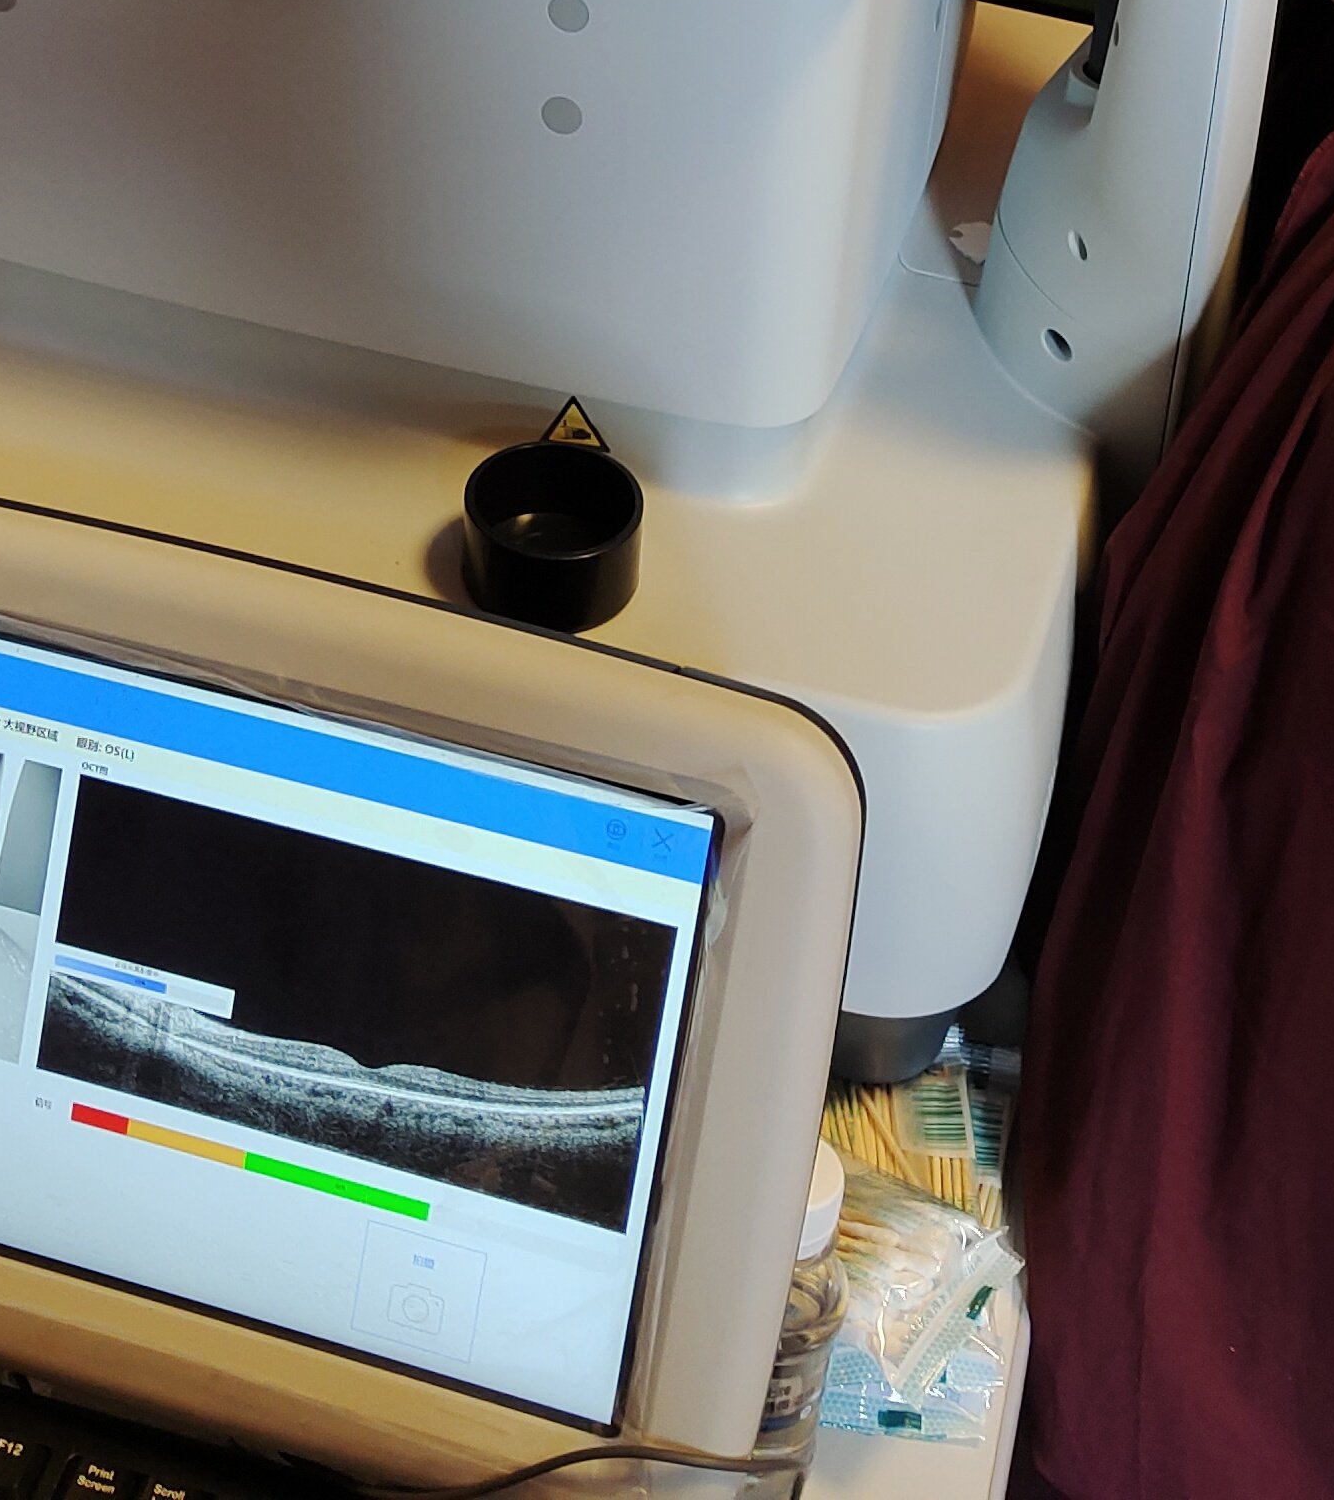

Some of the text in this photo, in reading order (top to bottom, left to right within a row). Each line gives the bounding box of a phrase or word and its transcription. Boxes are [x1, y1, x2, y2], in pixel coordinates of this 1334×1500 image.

[87, 1463, 116, 1482] Print
[76, 1474, 116, 1495] Screen
[152, 1483, 187, 1500] Scroll
